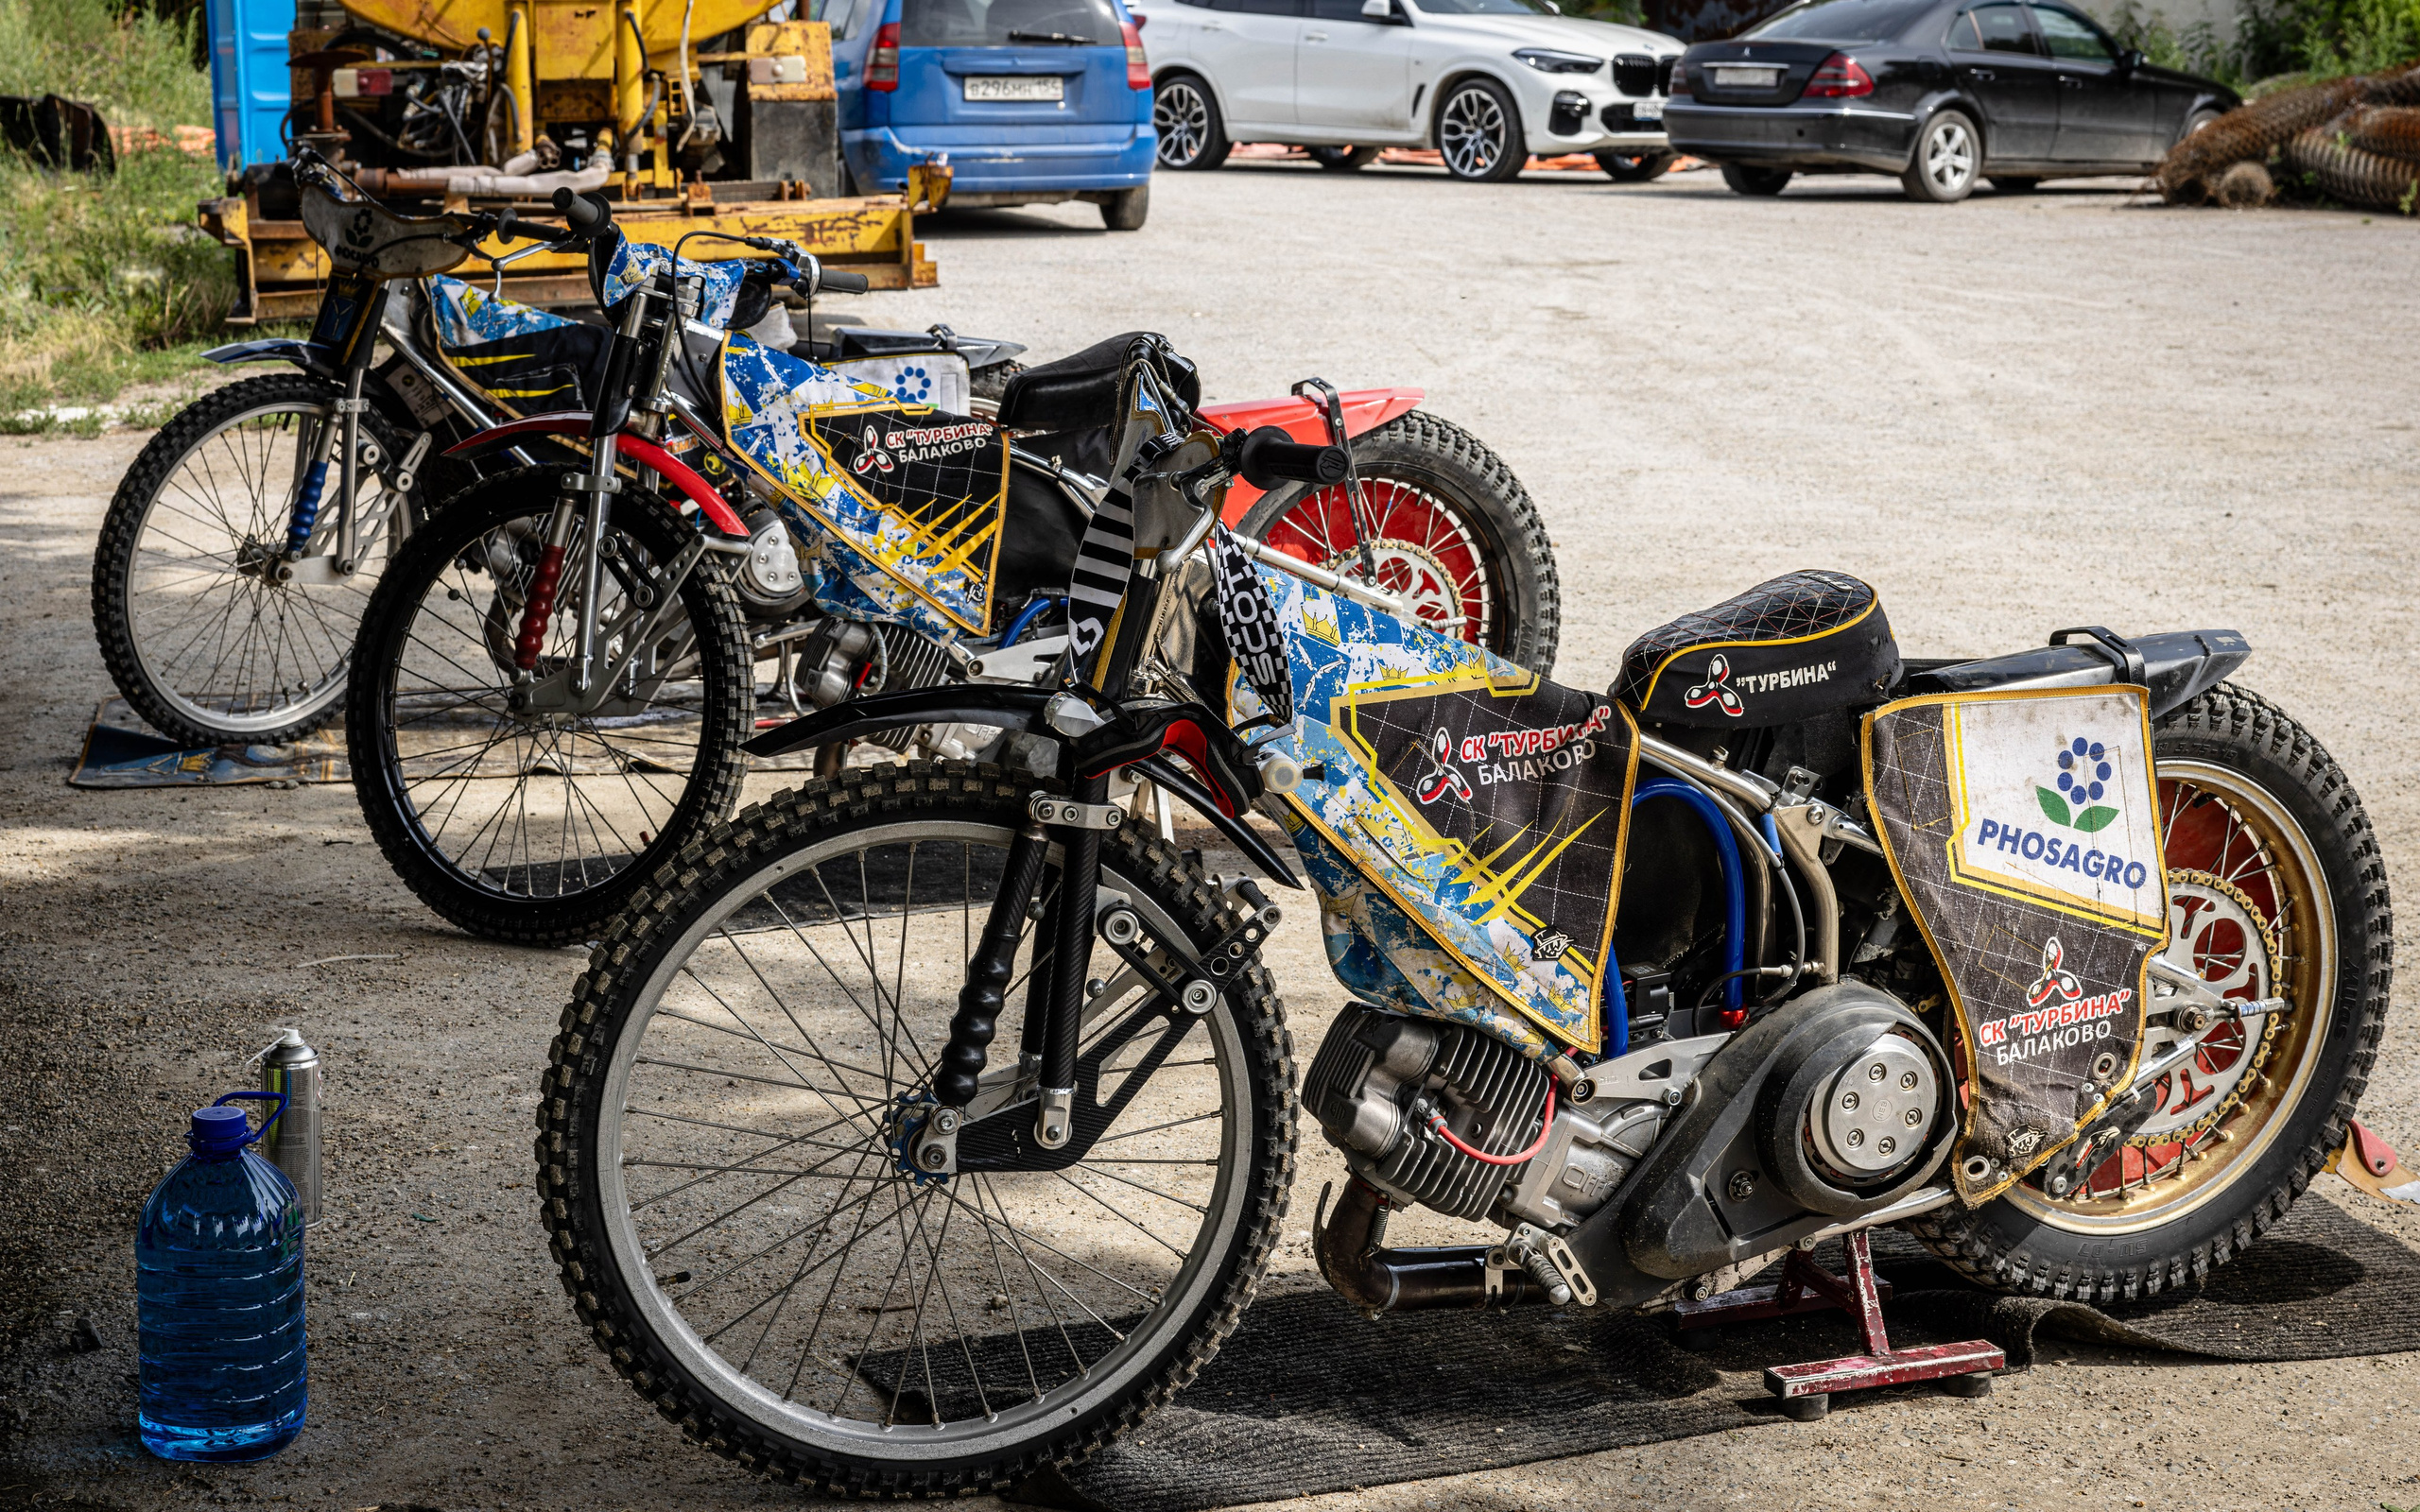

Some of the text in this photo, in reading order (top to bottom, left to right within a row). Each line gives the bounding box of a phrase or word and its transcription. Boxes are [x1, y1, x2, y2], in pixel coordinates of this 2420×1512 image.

[334, 244, 380, 268] ФОСАО
[886, 423, 994, 449] СК "ТУРБИНА"
[899, 438, 987, 463] БАЛАКОВО
[1736, 661, 1837, 694] "ТУРБИНА"
[1461, 735, 1487, 763] СК
[1477, 739, 1596, 785] БАЛАКОВО
[1978, 818, 2146, 889] PHOSAGRO
[1979, 988, 2132, 1047] СК "ТУРБИНА"
[1996, 1020, 2111, 1066] БАЛАКОВО
